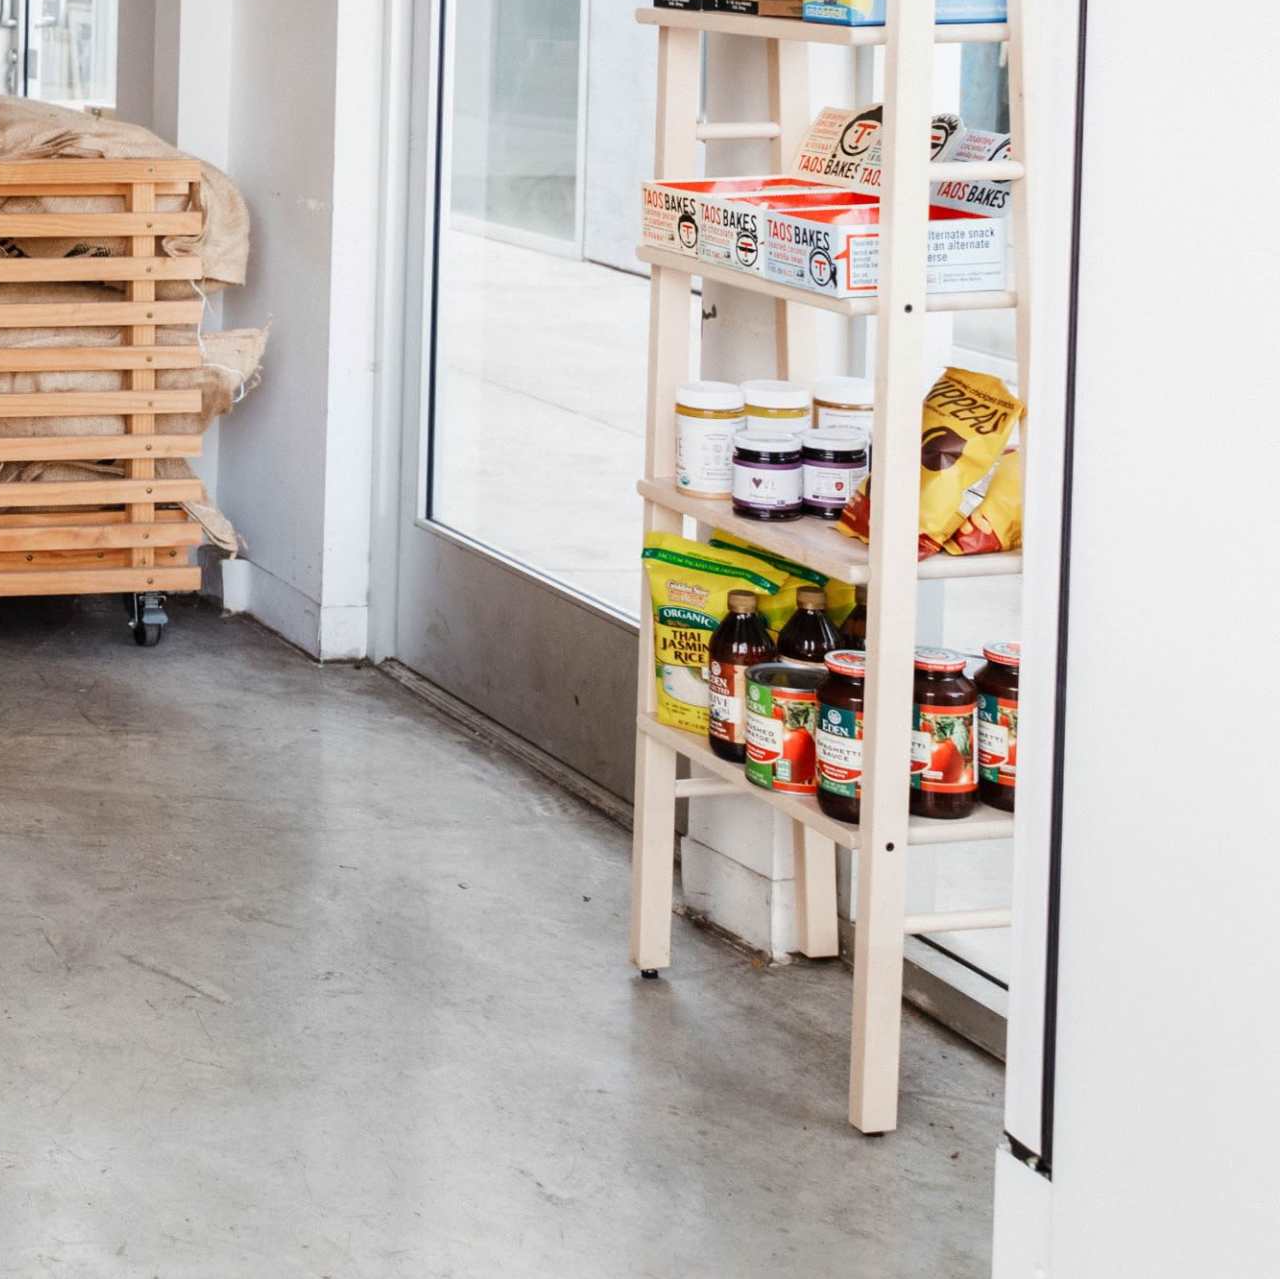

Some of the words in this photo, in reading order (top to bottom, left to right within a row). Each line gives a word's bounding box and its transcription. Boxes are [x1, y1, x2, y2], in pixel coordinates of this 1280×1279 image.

[798, 154, 825, 172] TAOS
[643, 188, 664, 208] TAOS
[664, 193, 697, 217] BAKES
[936, 181, 966, 201] TAOS
[966, 185, 1011, 209] BAKES
[700, 203, 721, 225] TAOS
[722, 209, 758, 233] BAKES
[768, 219, 793, 243] TAOS
[794, 226, 831, 251] BAKES
[928, 229, 965, 241] lternate
[968, 227, 995, 238] snack
[947, 239, 990, 250] alternate
[928, 253, 948, 263] erse
[663, 608, 713, 628] ORGANIC
[661, 637, 710, 652] JASMIN
[671, 630, 701, 642] THAI
[674, 652, 705, 664] RICE
[822, 718, 850, 737] EDEN
